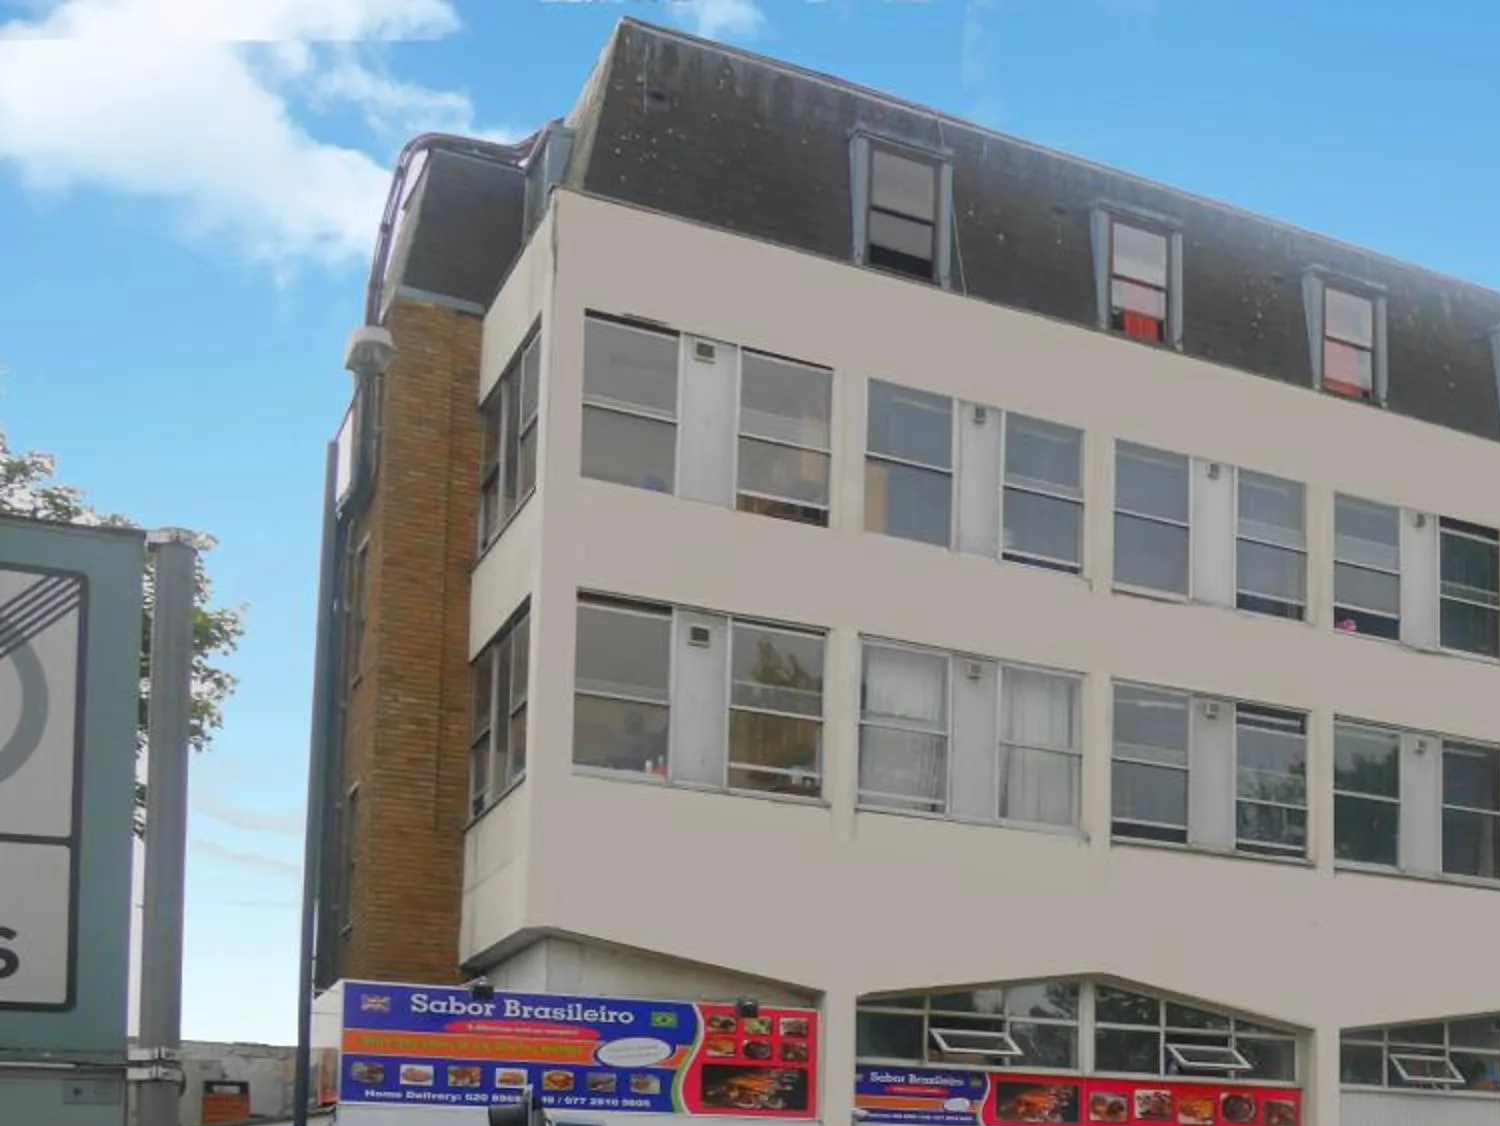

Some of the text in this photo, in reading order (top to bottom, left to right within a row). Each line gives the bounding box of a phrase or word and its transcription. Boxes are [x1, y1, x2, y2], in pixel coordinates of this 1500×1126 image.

[411, 994, 634, 1024] Sabor Brasileiro
[870, 1072, 964, 1086] Sabor Brasileiro
